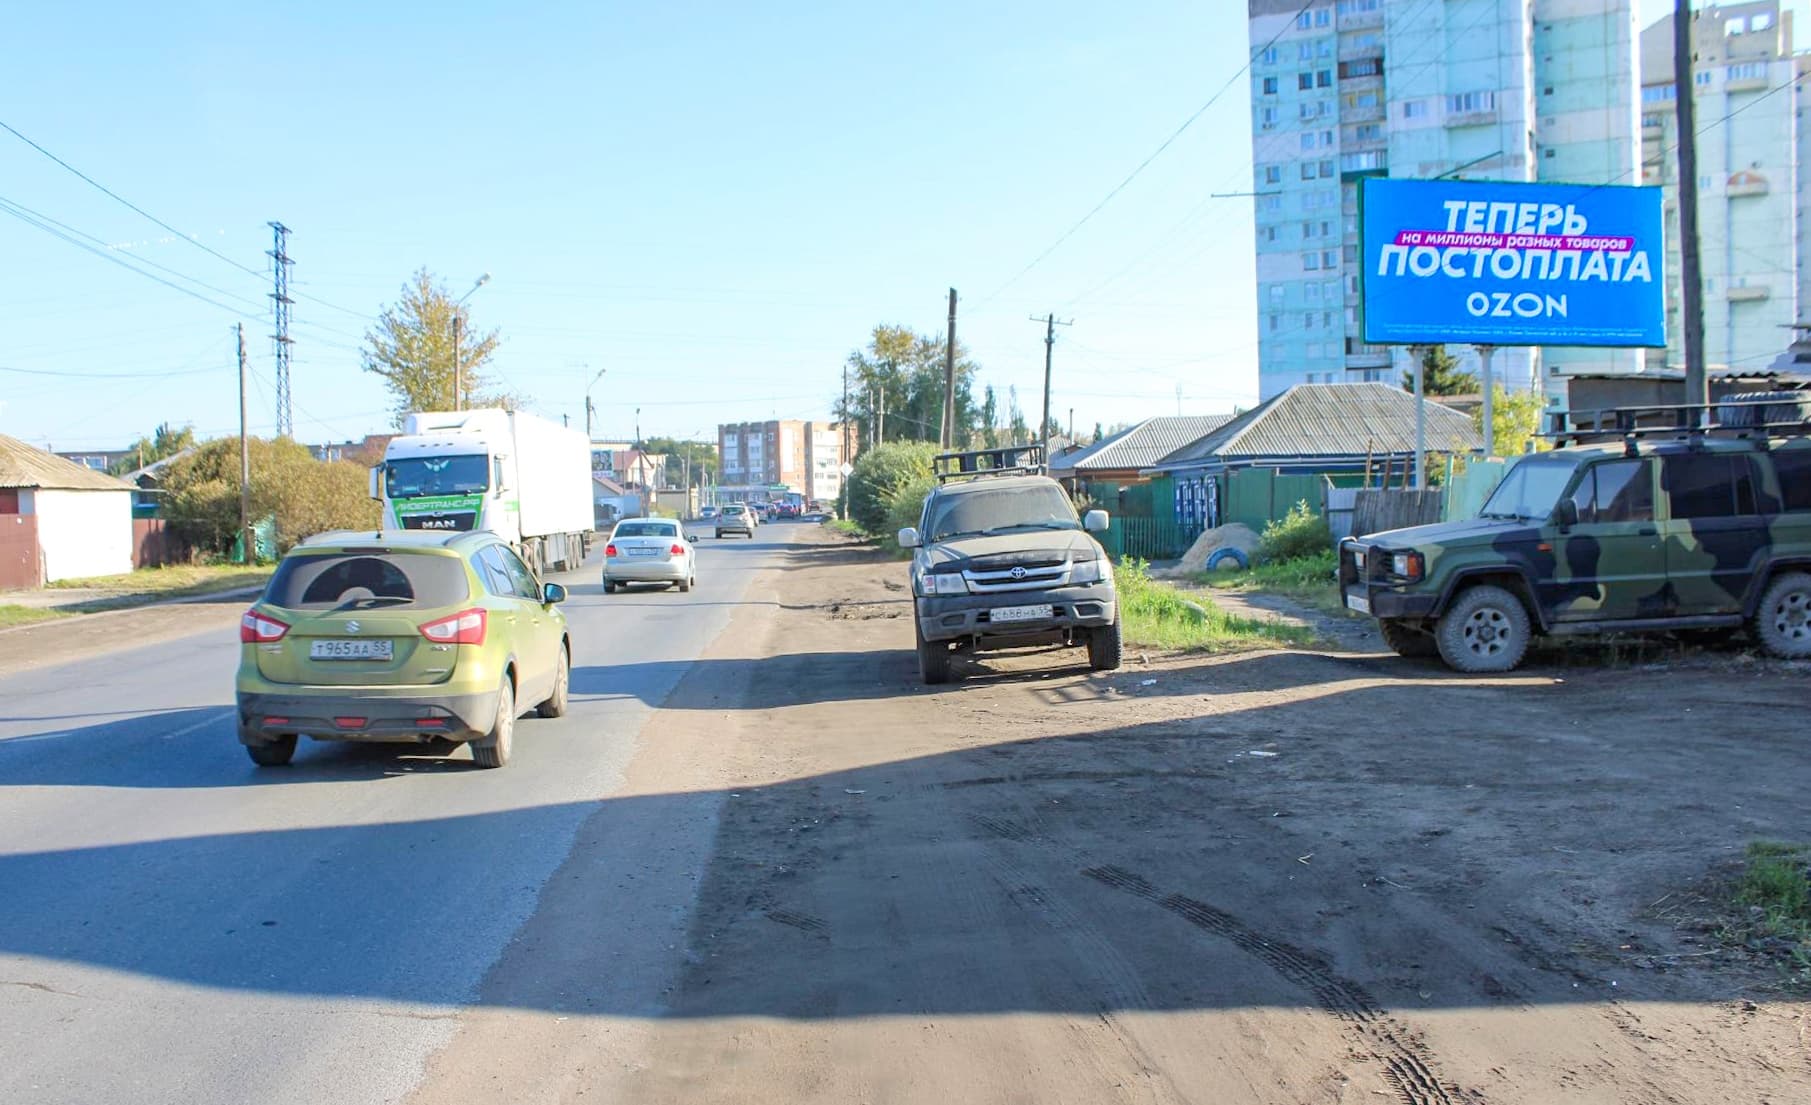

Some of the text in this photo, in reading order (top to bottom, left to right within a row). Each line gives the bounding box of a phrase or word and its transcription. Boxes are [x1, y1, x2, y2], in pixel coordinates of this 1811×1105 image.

[1444, 200, 1587, 235] ТЕПЕРЬ
[1401, 232, 1627, 251] на миллионы разных товаров
[1377, 244, 1652, 282] ПОСТОПЛАТА
[1466, 291, 1568, 318] OZON
[421, 520, 456, 529] MAN
